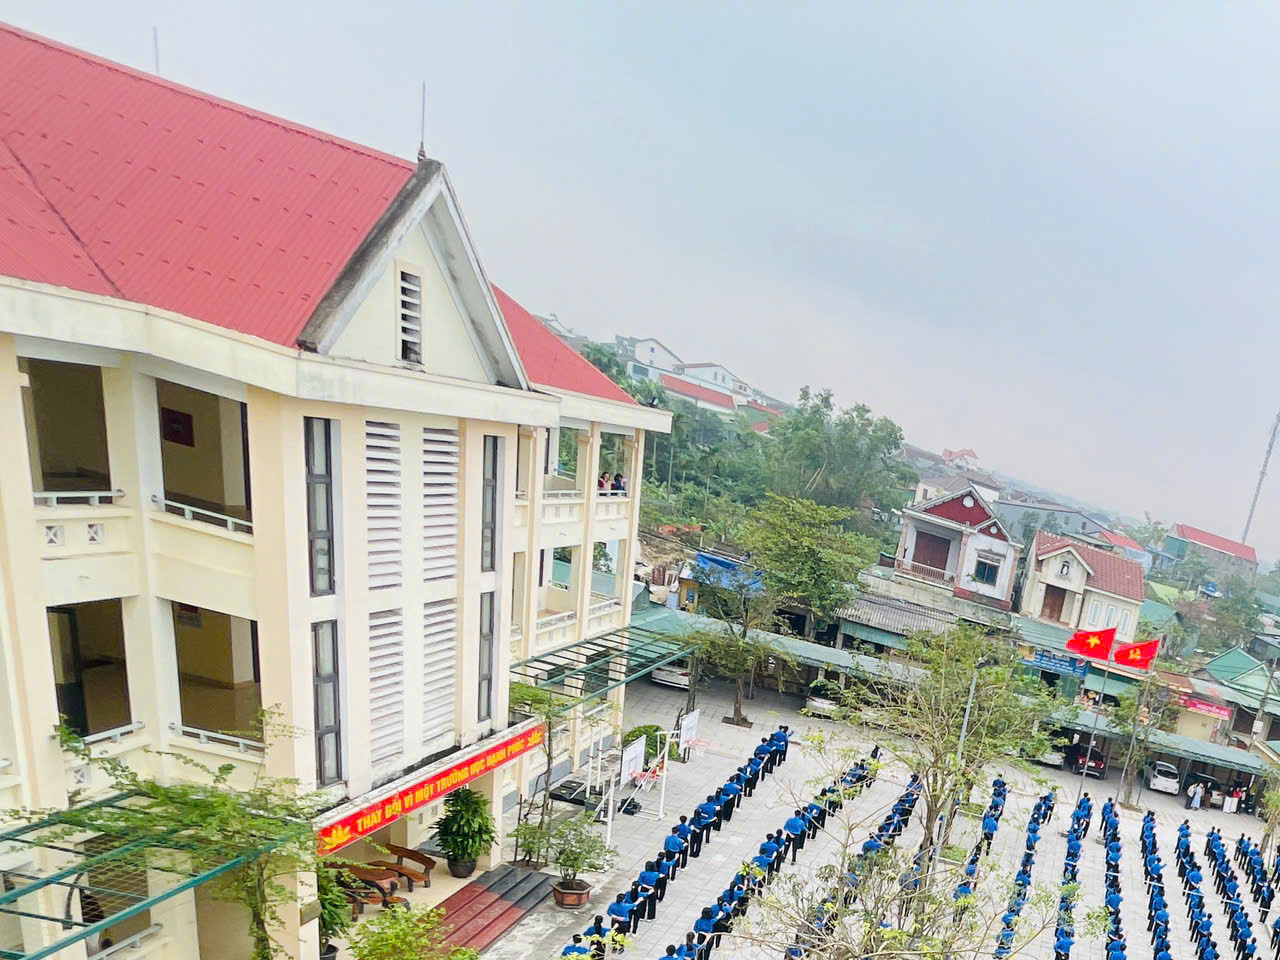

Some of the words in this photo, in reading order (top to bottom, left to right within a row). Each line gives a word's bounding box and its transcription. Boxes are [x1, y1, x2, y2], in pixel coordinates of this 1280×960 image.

[356, 808, 383, 832] THAY
[385, 794, 402, 818] ĐỔI
[404, 791, 414, 808] VÌ
[415, 783, 435, 803] MỘT
[435, 766, 469, 793] TRƯỜNG
[470, 758, 486, 776] HỌC
[486, 749, 506, 767] HẠNH
[507, 738, 526, 757] PHÚC
